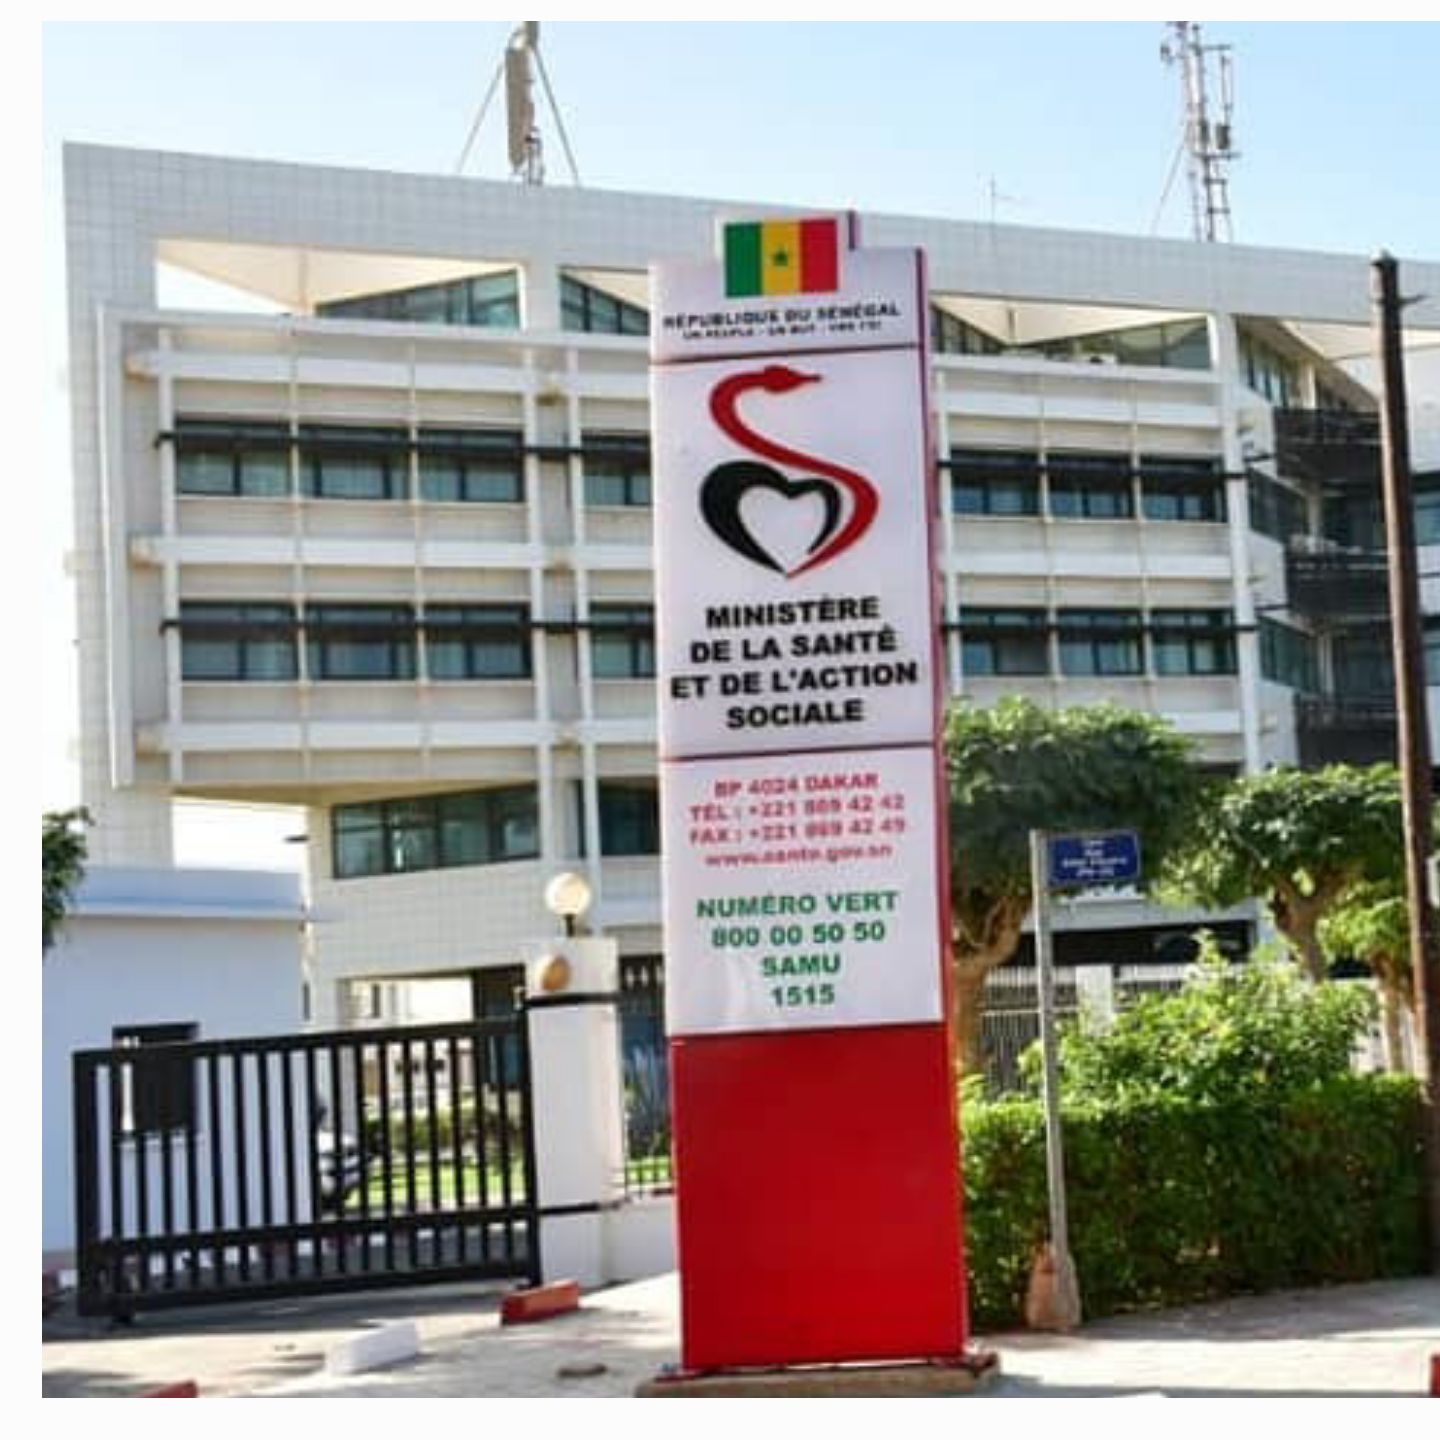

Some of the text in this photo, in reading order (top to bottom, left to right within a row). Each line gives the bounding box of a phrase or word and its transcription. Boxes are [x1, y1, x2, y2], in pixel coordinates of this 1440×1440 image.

[785, 308, 812, 322] DU
[706, 594, 880, 629] MINISTÈRE
[690, 622, 896, 663] DE LA SANTÉ
[671, 661, 918, 699] ET DE L'ACTION
[726, 699, 865, 730] SOCIALE
[715, 773, 879, 797] BP 4024 DAKAR
[848, 795, 873, 811] 42
[849, 819, 873, 834] 42
[696, 890, 898, 918] NUMÉRO VERT
[712, 921, 885, 948] 800 00 50 50
[762, 952, 841, 976] SAMU
[771, 983, 835, 1007] 1515
